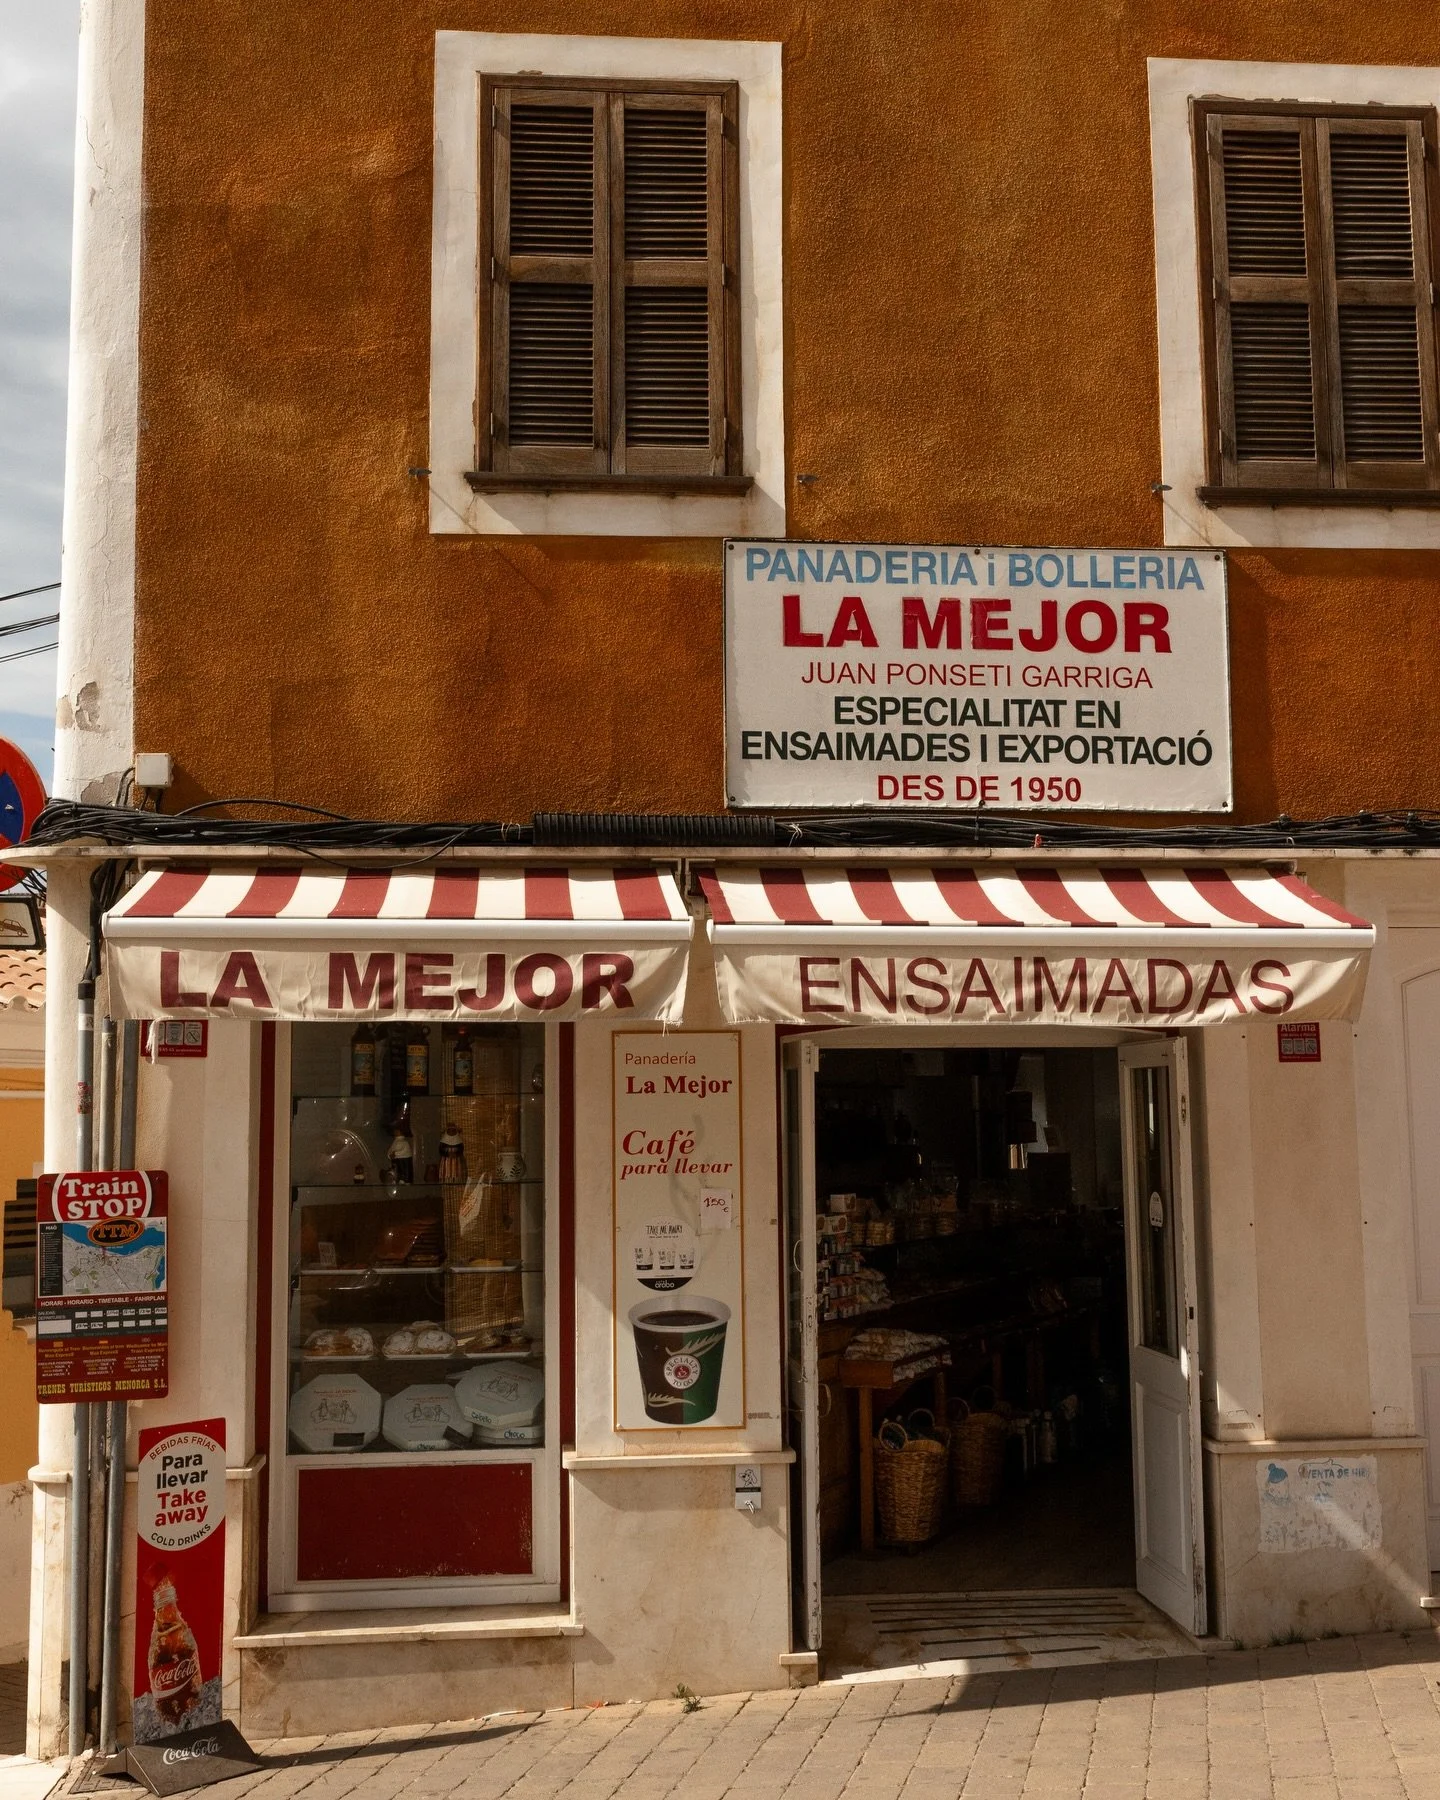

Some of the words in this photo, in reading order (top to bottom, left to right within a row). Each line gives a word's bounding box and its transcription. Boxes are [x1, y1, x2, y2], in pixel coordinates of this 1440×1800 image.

[746, 548, 977, 586] PANADERIA
[1008, 553, 1205, 591] BOLLERIA
[782, 594, 879, 648] LA
[901, 596, 1173, 654] MEJOR
[801, 661, 877, 685] JUAN
[887, 663, 1011, 687] PONSETI
[1021, 666, 1153, 689] GARRIGA
[834, 696, 1067, 728] ESPECIALITAT
[1075, 700, 1121, 729] EN
[741, 731, 970, 763] ENSAIMADES
[980, 734, 988, 762] I
[999, 730, 1213, 767] EXPORTACIÓ
[877, 775, 944, 801] DES
[955, 775, 1001, 802] DE
[1010, 777, 1082, 802] 1950
[159, 951, 273, 1009] LA
[328, 952, 636, 1011] MEJOR
[799, 955, 1295, 1016] ENSAIMADAS
[625, 1052, 696, 1065] Panadería
[626, 1076, 656, 1094] La
[663, 1075, 732, 1098] Mejor
[622, 1130, 695, 1163] Café
[620, 1162, 669, 1180] para
[674, 1158, 733, 1174] llevar
[62, 1177, 139, 1197] Train
[67, 1198, 143, 1219] STOP
[97, 1224, 137, 1238] TTM
[666, 1358, 698, 1376] SPECIALTY
[37, 1384, 66, 1395] TRENES
[70, 1381, 111, 1393] TURÍSTICOS
[115, 1379, 150, 1391] MENORCA
[150, 1436, 189, 1460] BEBIDAS
[191, 1436, 217, 1452] FRÍAS
[162, 1453, 203, 1471] Para
[156, 1469, 208, 1489] llevar
[157, 1488, 207, 1509] Take
[155, 1505, 209, 1527] away
[151, 1532, 175, 1546] COLD
[177, 1523, 212, 1546] DRINKS
